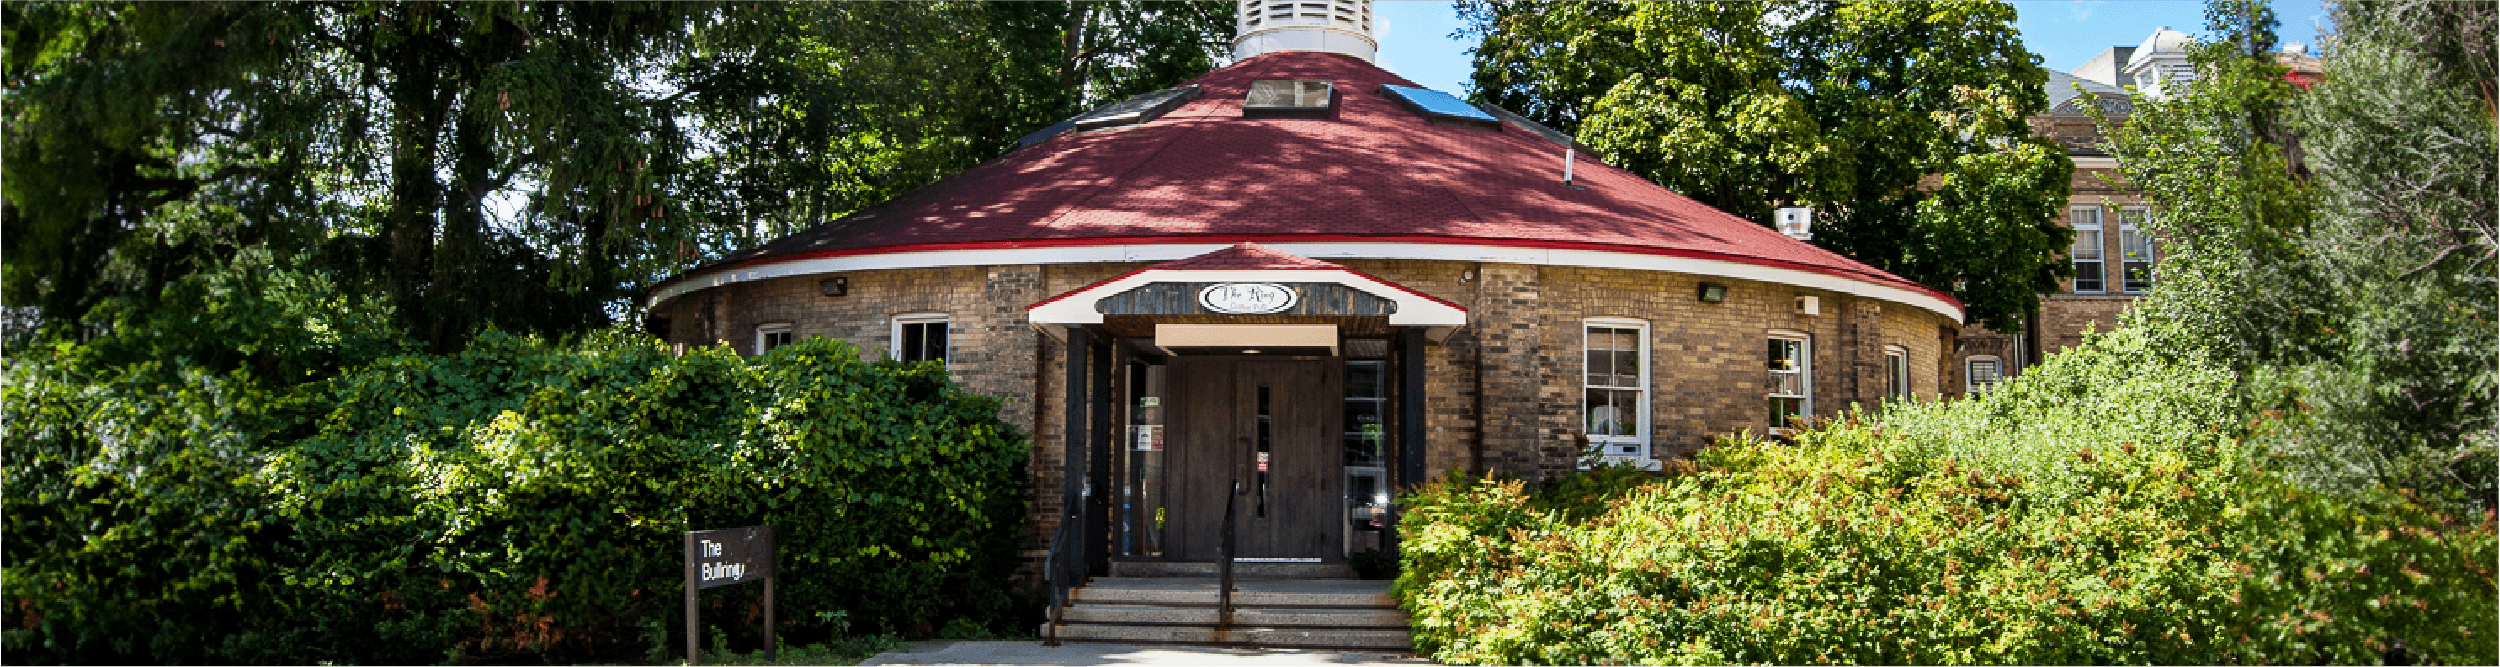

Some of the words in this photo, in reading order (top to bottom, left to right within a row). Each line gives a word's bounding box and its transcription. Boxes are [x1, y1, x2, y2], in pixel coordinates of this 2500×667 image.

[1219, 285, 1242, 302] The
[1245, 285, 1276, 304] Ring
[700, 539, 722, 558] The
